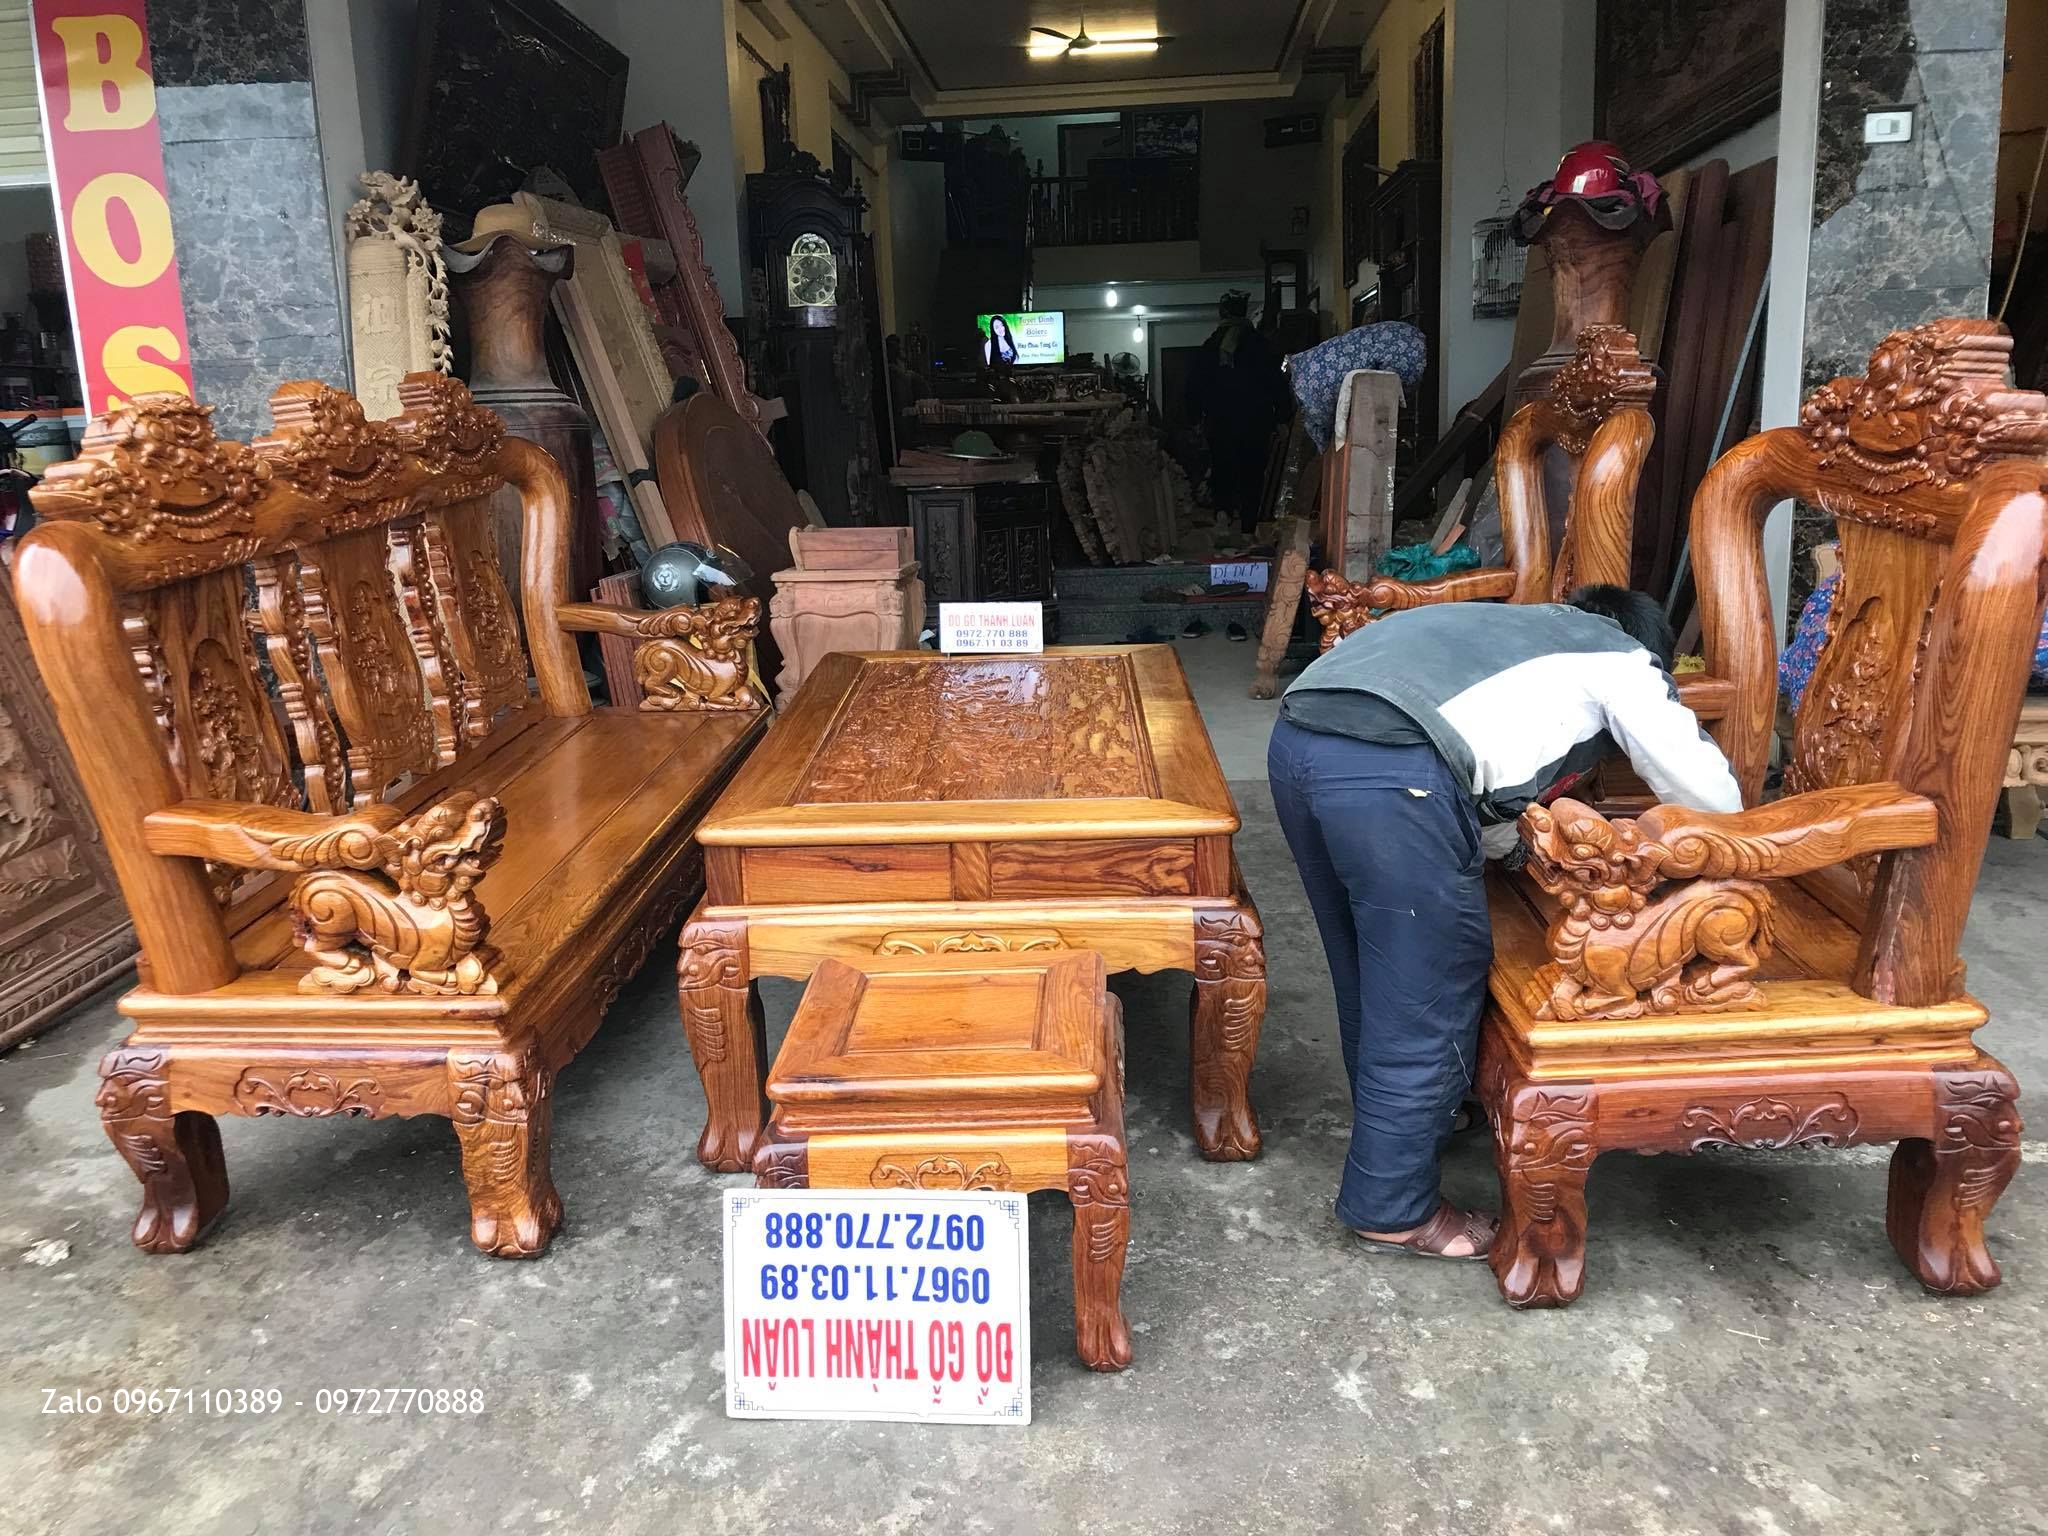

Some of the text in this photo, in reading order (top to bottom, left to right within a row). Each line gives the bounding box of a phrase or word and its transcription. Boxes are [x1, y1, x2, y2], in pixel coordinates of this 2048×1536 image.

[765, 1212, 985, 1251] 0972.770.888
[760, 1264, 990, 1304] 0967.11.03.89
[742, 1318, 1013, 1405] ĐỒ GỖ THÀNH LUÂN
